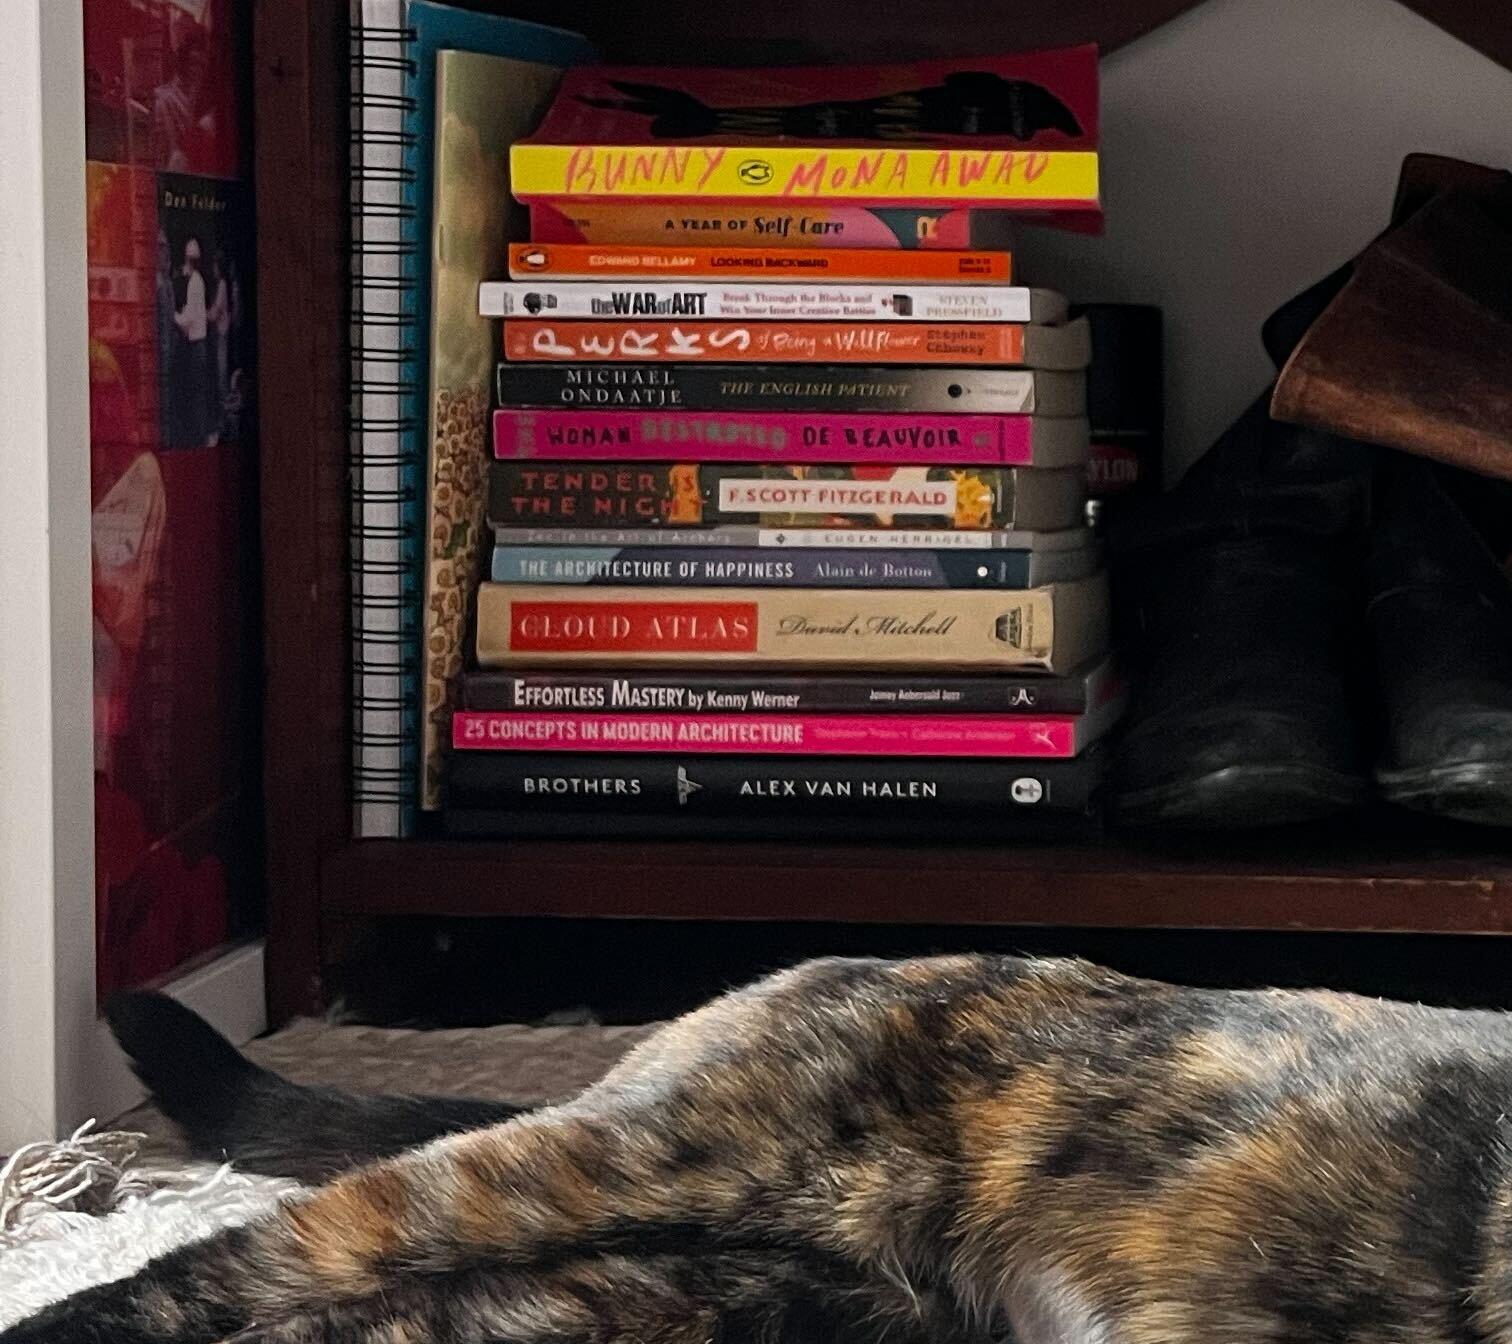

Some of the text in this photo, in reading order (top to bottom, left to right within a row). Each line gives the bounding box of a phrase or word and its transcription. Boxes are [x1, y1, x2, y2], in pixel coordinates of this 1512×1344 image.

[565, 146, 1049, 197] BUNNY MONA AWAD
[665, 217, 844, 239] A YEAR OF Self Care
[589, 256, 829, 269] EDWARD BELLAMY LOOKING BACKWARD
[723, 292, 751, 303] Break
[756, 293, 797, 305] Through
[800, 293, 816, 303] the
[818, 293, 852, 304] Blocks
[720, 305, 741, 316] Win
[743, 305, 767, 316] Your
[800, 306, 841, 317] Creative
[532, 326, 751, 357] PERKS
[566, 369, 675, 385] MICHAEL
[561, 388, 683, 404] ONDAATJE
[721, 382, 911, 398] THE ENGLISH PATIENT
[546, 425, 632, 446] WOMAN
[802, 425, 831, 448] DE
[843, 425, 961, 449] BEAUVOIR
[520, 471, 656, 492] TENDER
[511, 496, 577, 517] THE
[747, 488, 810, 504] SCOTT
[818, 489, 947, 505] FITZGERALD
[824, 534, 878, 544] EUGEN
[519, 559, 795, 579] THE ARCHITECTURE OF HAPPINESS
[815, 562, 933, 577] Alain de Botton
[520, 614, 751, 640] CLOUD ATLAS
[776, 609, 959, 638] David Mitchell
[513, 678, 801, 713] EFFORTLESS MASTERY by Kenny Werner
[464, 719, 486, 738] 25
[488, 719, 577, 740] CONCEPTS
[580, 720, 600, 740] IN
[601, 721, 674, 742] MODERN
[676, 722, 804, 744] ARCHITECTURE
[523, 777, 938, 799] BROTHERS ALEX VAN HALEN
